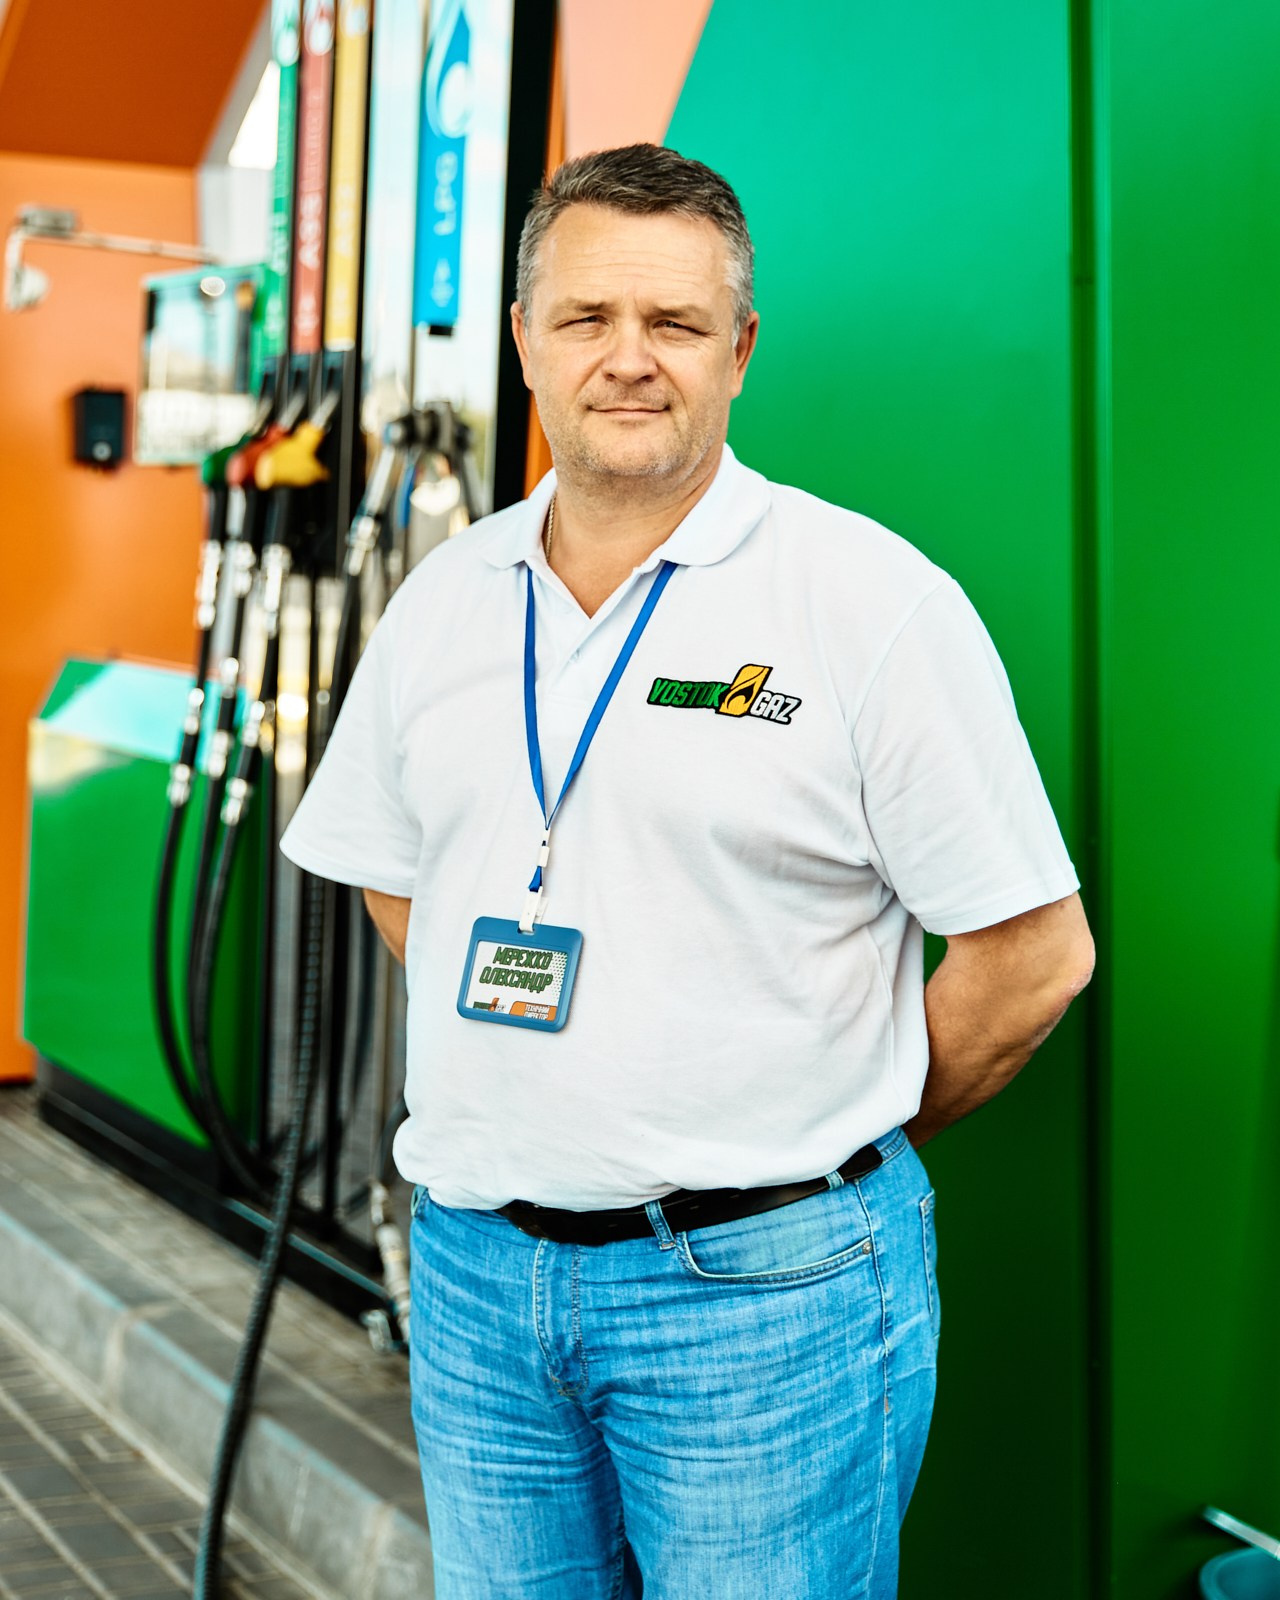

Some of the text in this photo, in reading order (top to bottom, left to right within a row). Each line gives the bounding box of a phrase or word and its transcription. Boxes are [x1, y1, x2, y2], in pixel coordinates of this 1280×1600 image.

[649, 678, 801, 723] VOSTOK GAZ
[492, 946, 553, 970] МЕРЕЖКО
[479, 966, 553, 994] ОЛЕКСАНДР
